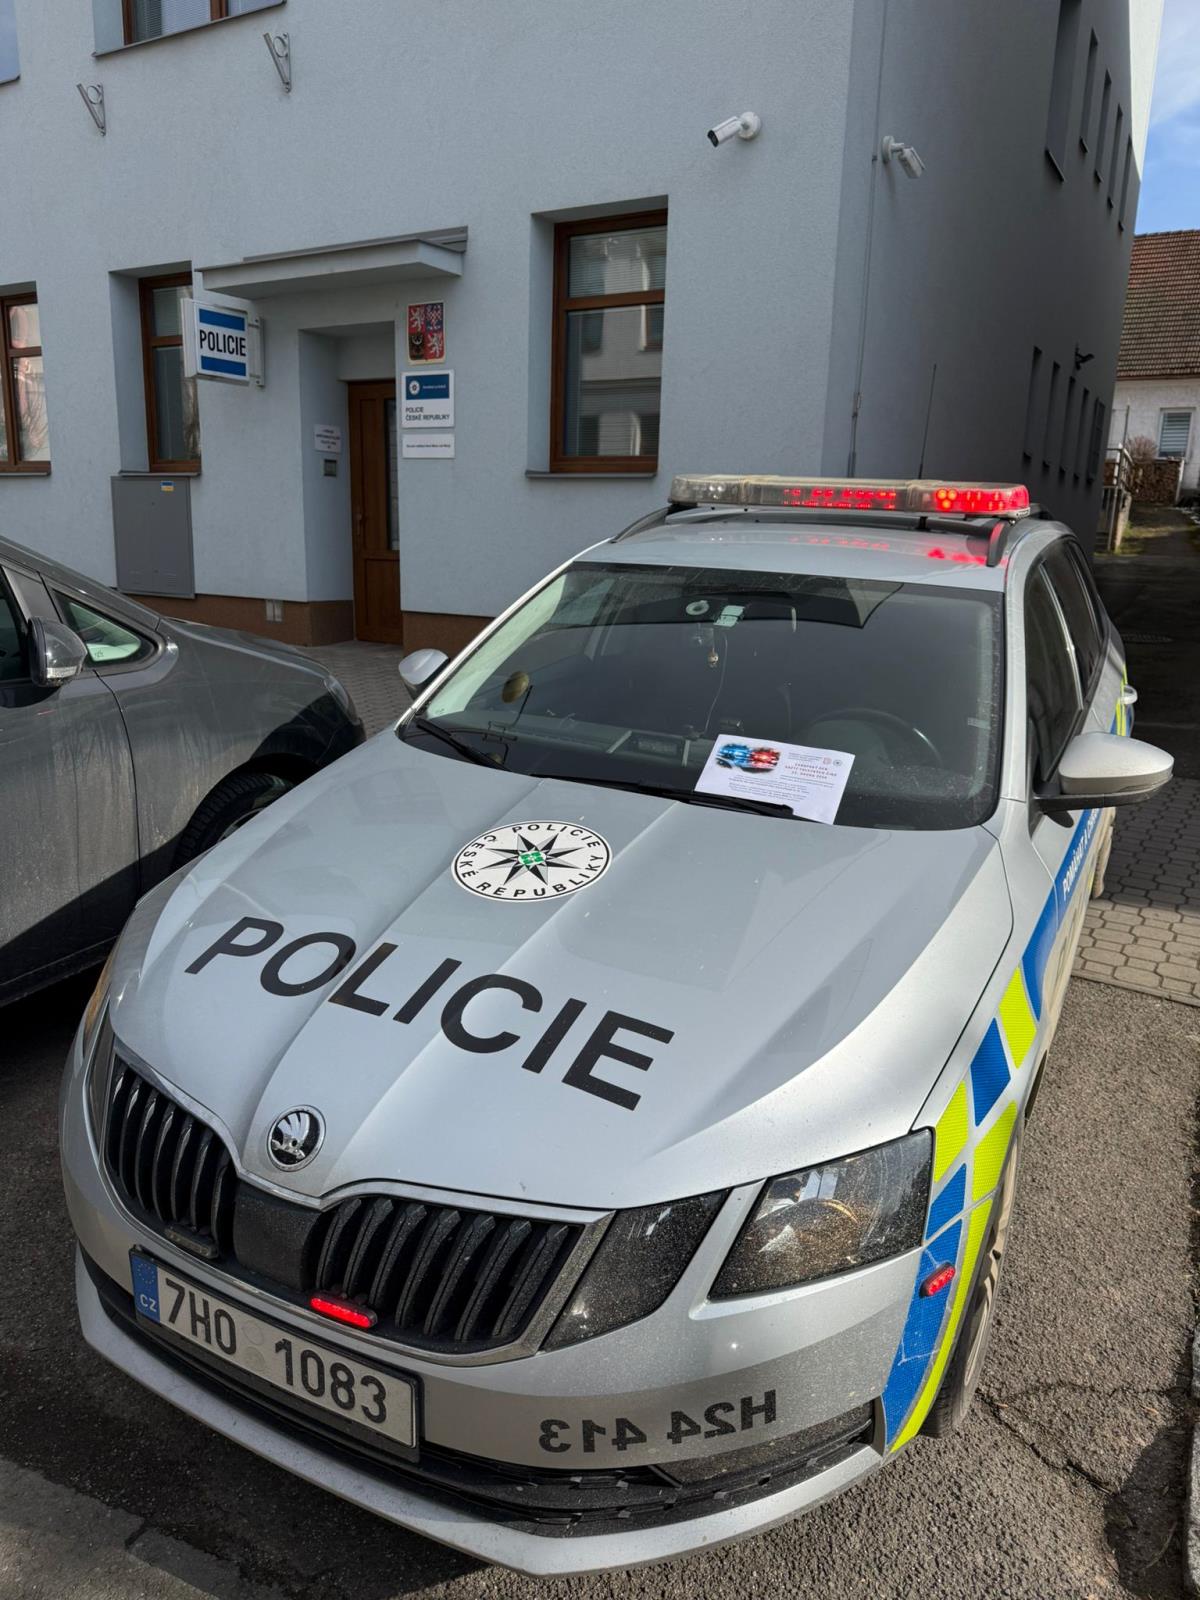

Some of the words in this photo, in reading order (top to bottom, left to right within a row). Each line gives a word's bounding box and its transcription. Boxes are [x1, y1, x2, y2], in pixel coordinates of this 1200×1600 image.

[199, 329, 247, 357] POLICIE
[405, 406, 424, 414] POLICIE
[405, 413, 422, 421] ČESKÉ
[423, 413, 450, 421] REPUBLIKY
[511, 823, 601, 848] POLICIE
[459, 834, 498, 879] ČESKÉ
[475, 854, 604, 898] REPUBLIKY
[184, 915, 675, 1111] POLICIE
[139, 1293, 157, 1313] CZ
[165, 1277, 237, 1355] 7H0
[274, 1338, 387, 1424] 1083
